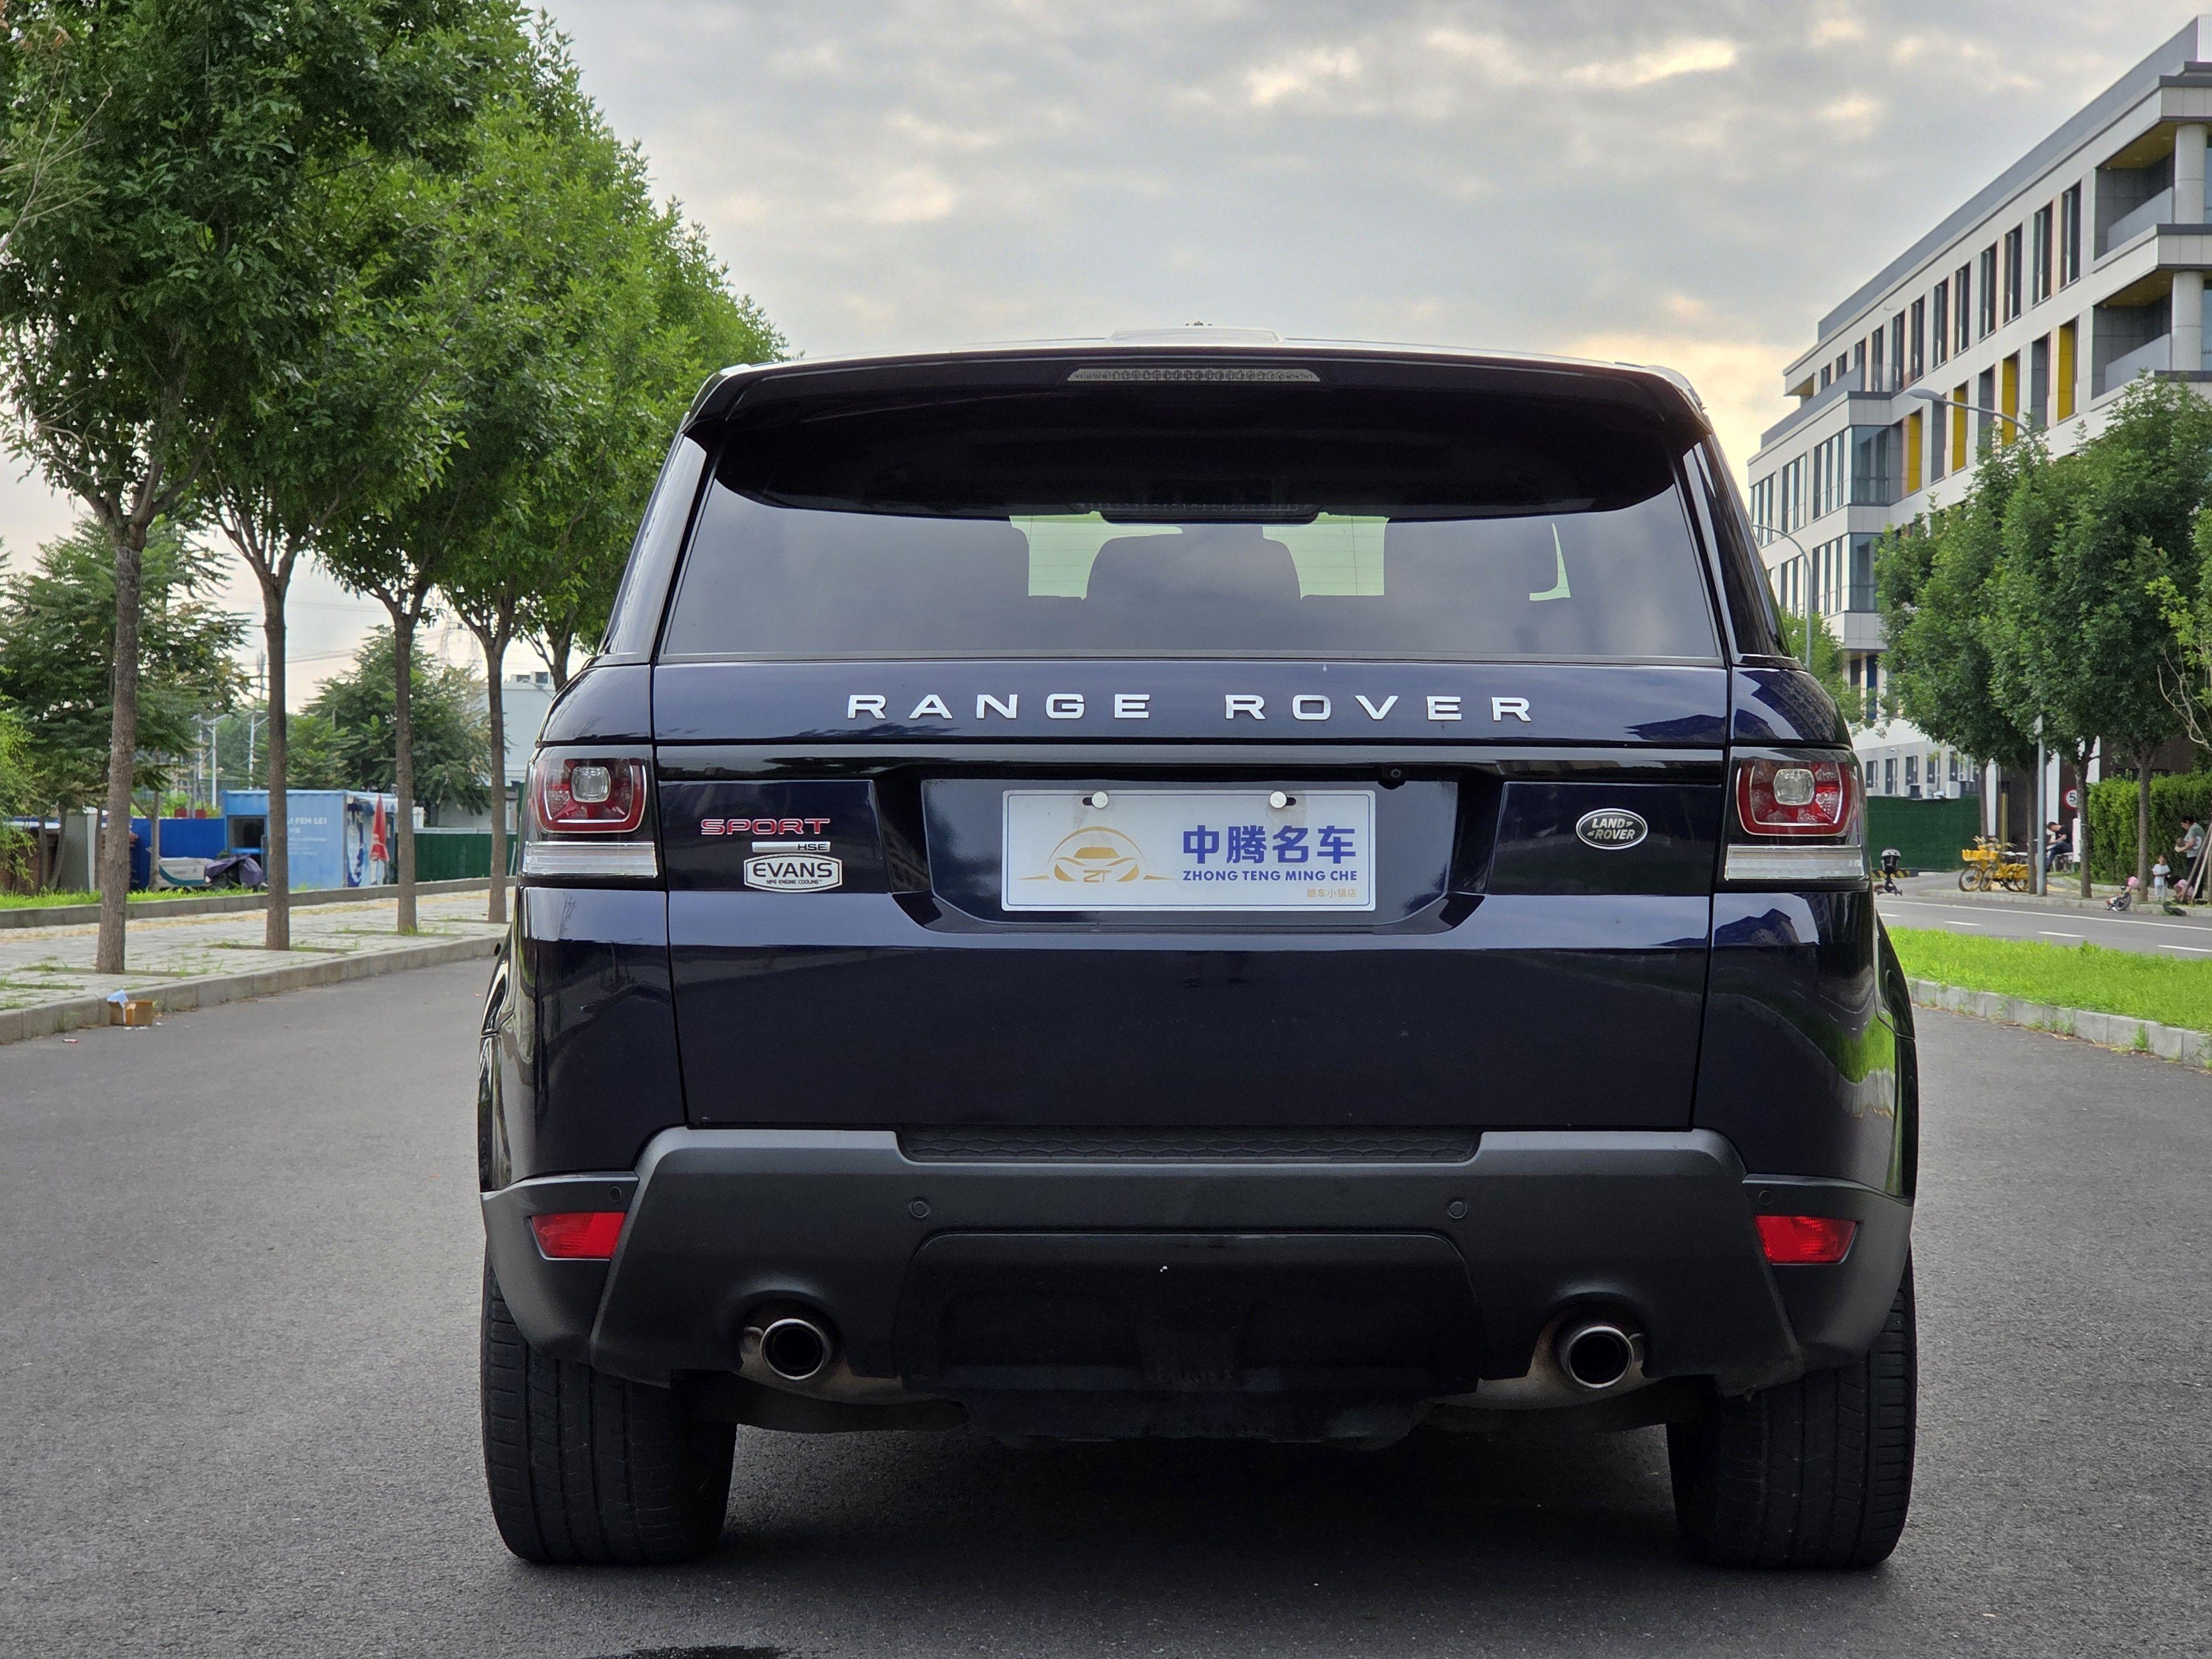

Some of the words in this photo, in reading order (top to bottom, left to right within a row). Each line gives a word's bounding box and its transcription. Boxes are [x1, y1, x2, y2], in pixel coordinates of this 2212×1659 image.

[847, 693, 1150, 719] RANGE
[1225, 694, 1532, 721] ROVER
[701, 818, 830, 835] SPORT
[1592, 818, 1626, 828] LAND
[1594, 829, 1636, 839] ROVER
[1183, 825, 1356, 864] 中腾名车
[753, 863, 832, 878] EVANS
[1183, 870, 1238, 881] ZHONG
[1242, 870, 1281, 881] TENG
[1285, 870, 1326, 881] MING
[1330, 870, 1357, 881] CHE
